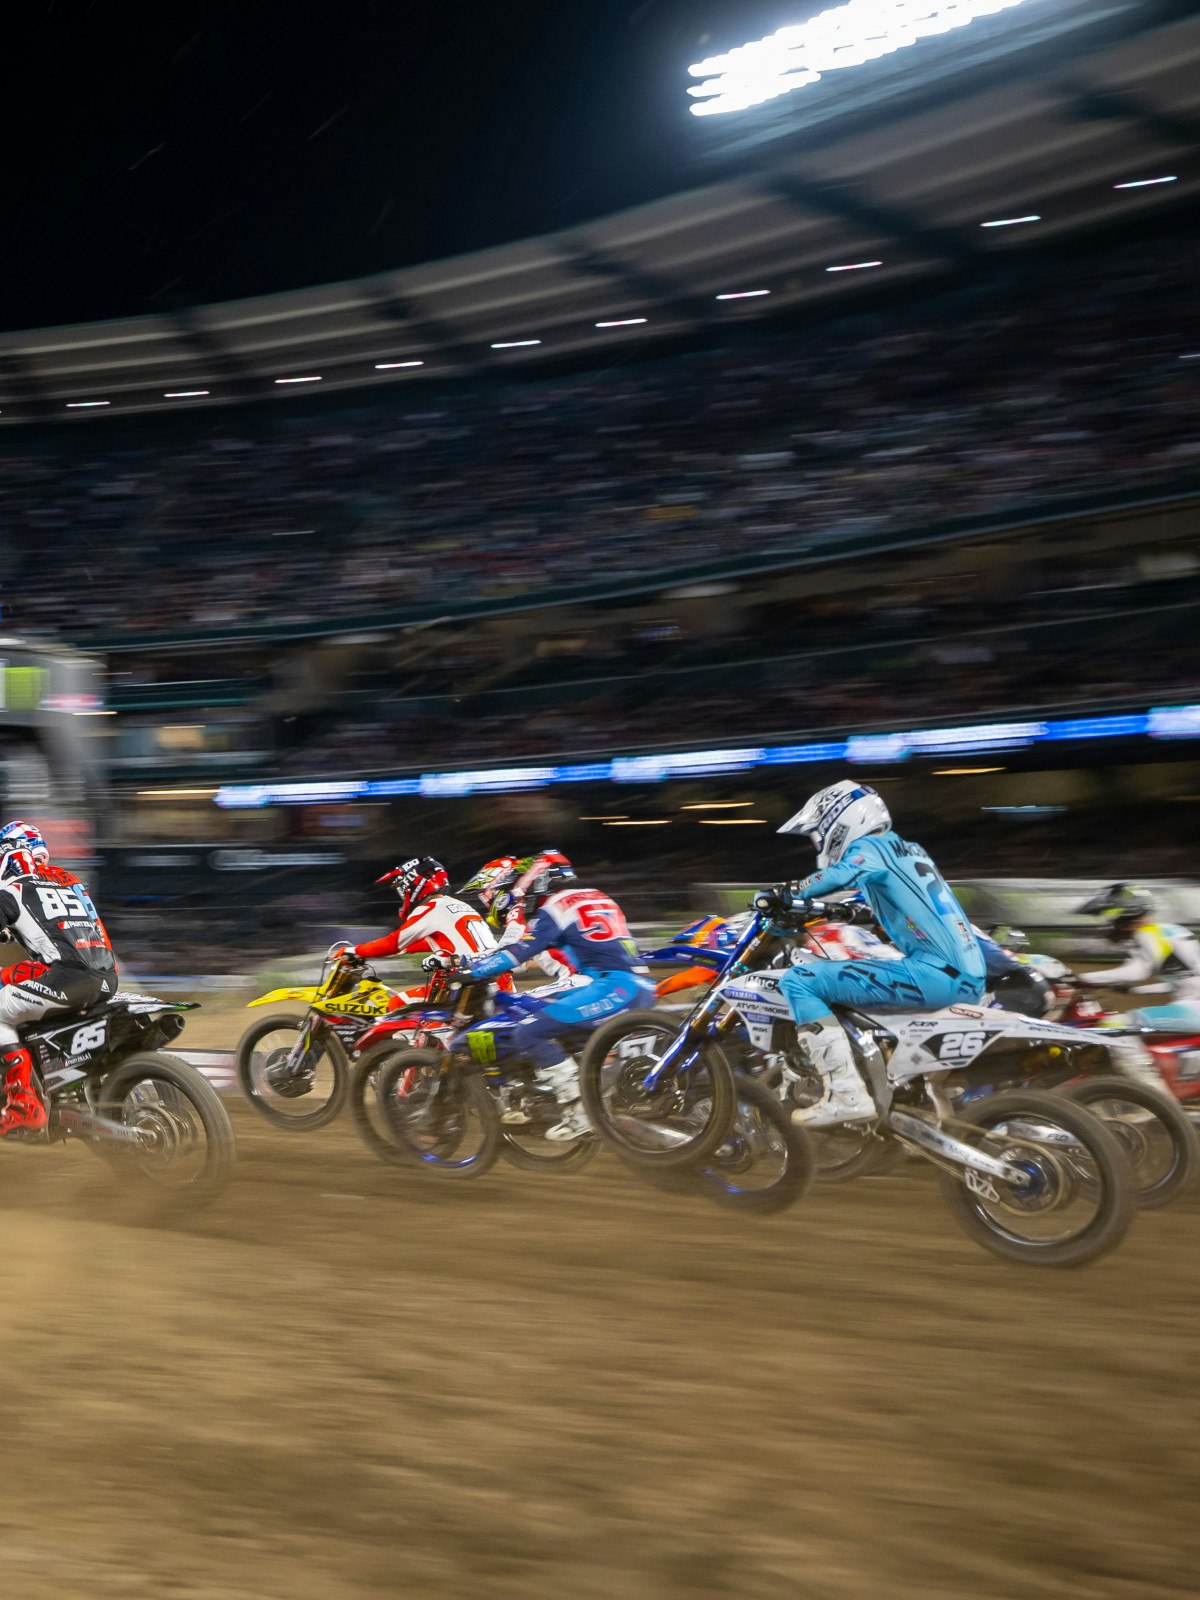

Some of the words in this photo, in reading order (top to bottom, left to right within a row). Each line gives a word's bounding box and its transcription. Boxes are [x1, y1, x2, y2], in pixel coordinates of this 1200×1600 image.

[35, 887, 88, 920] 85
[71, 1020, 108, 1056] 85
[939, 1031, 987, 1060] 26
